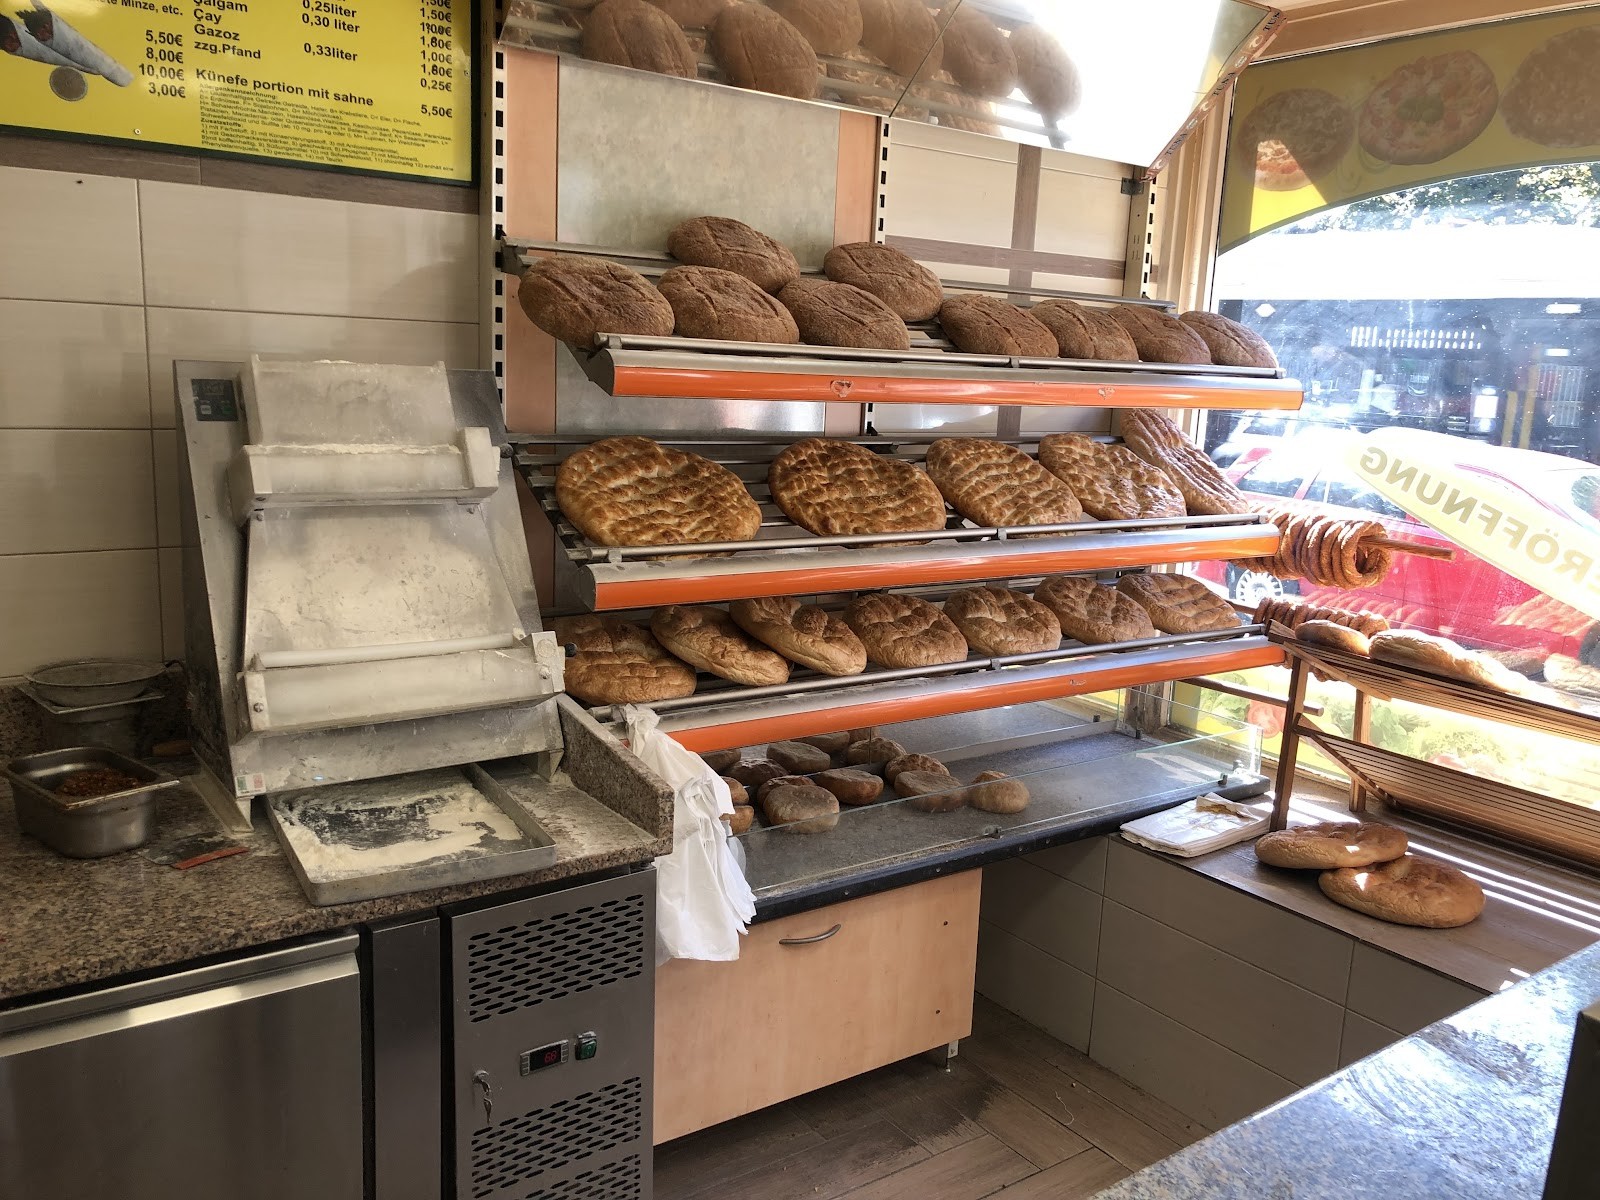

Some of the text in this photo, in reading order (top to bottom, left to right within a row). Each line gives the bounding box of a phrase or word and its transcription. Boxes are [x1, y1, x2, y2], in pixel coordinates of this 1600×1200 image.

[162, 4, 183, 15] etc.
[193, 8, 222, 25] Çay
[302, 0, 357, 18] 0,25liter
[420, 7, 452, 23] 1,50€
[302, 13, 360, 33] 0,30 liter
[145, 29, 183, 47] 5,50€
[194, 24, 240, 41] Gazoz
[146, 47, 184, 64] 8,00€
[194, 41, 261, 59] zzg.Pfand
[303, 42, 358, 61] 0,33liter
[420, 50, 452, 64] 1,00€
[138, 63, 184, 81] 10,00€
[148, 82, 186, 98] 3,00€
[196, 68, 374, 106] Künefe portion mit sahne
[420, 78, 452, 92] 0,25€
[421, 104, 453, 119] 5,50€
